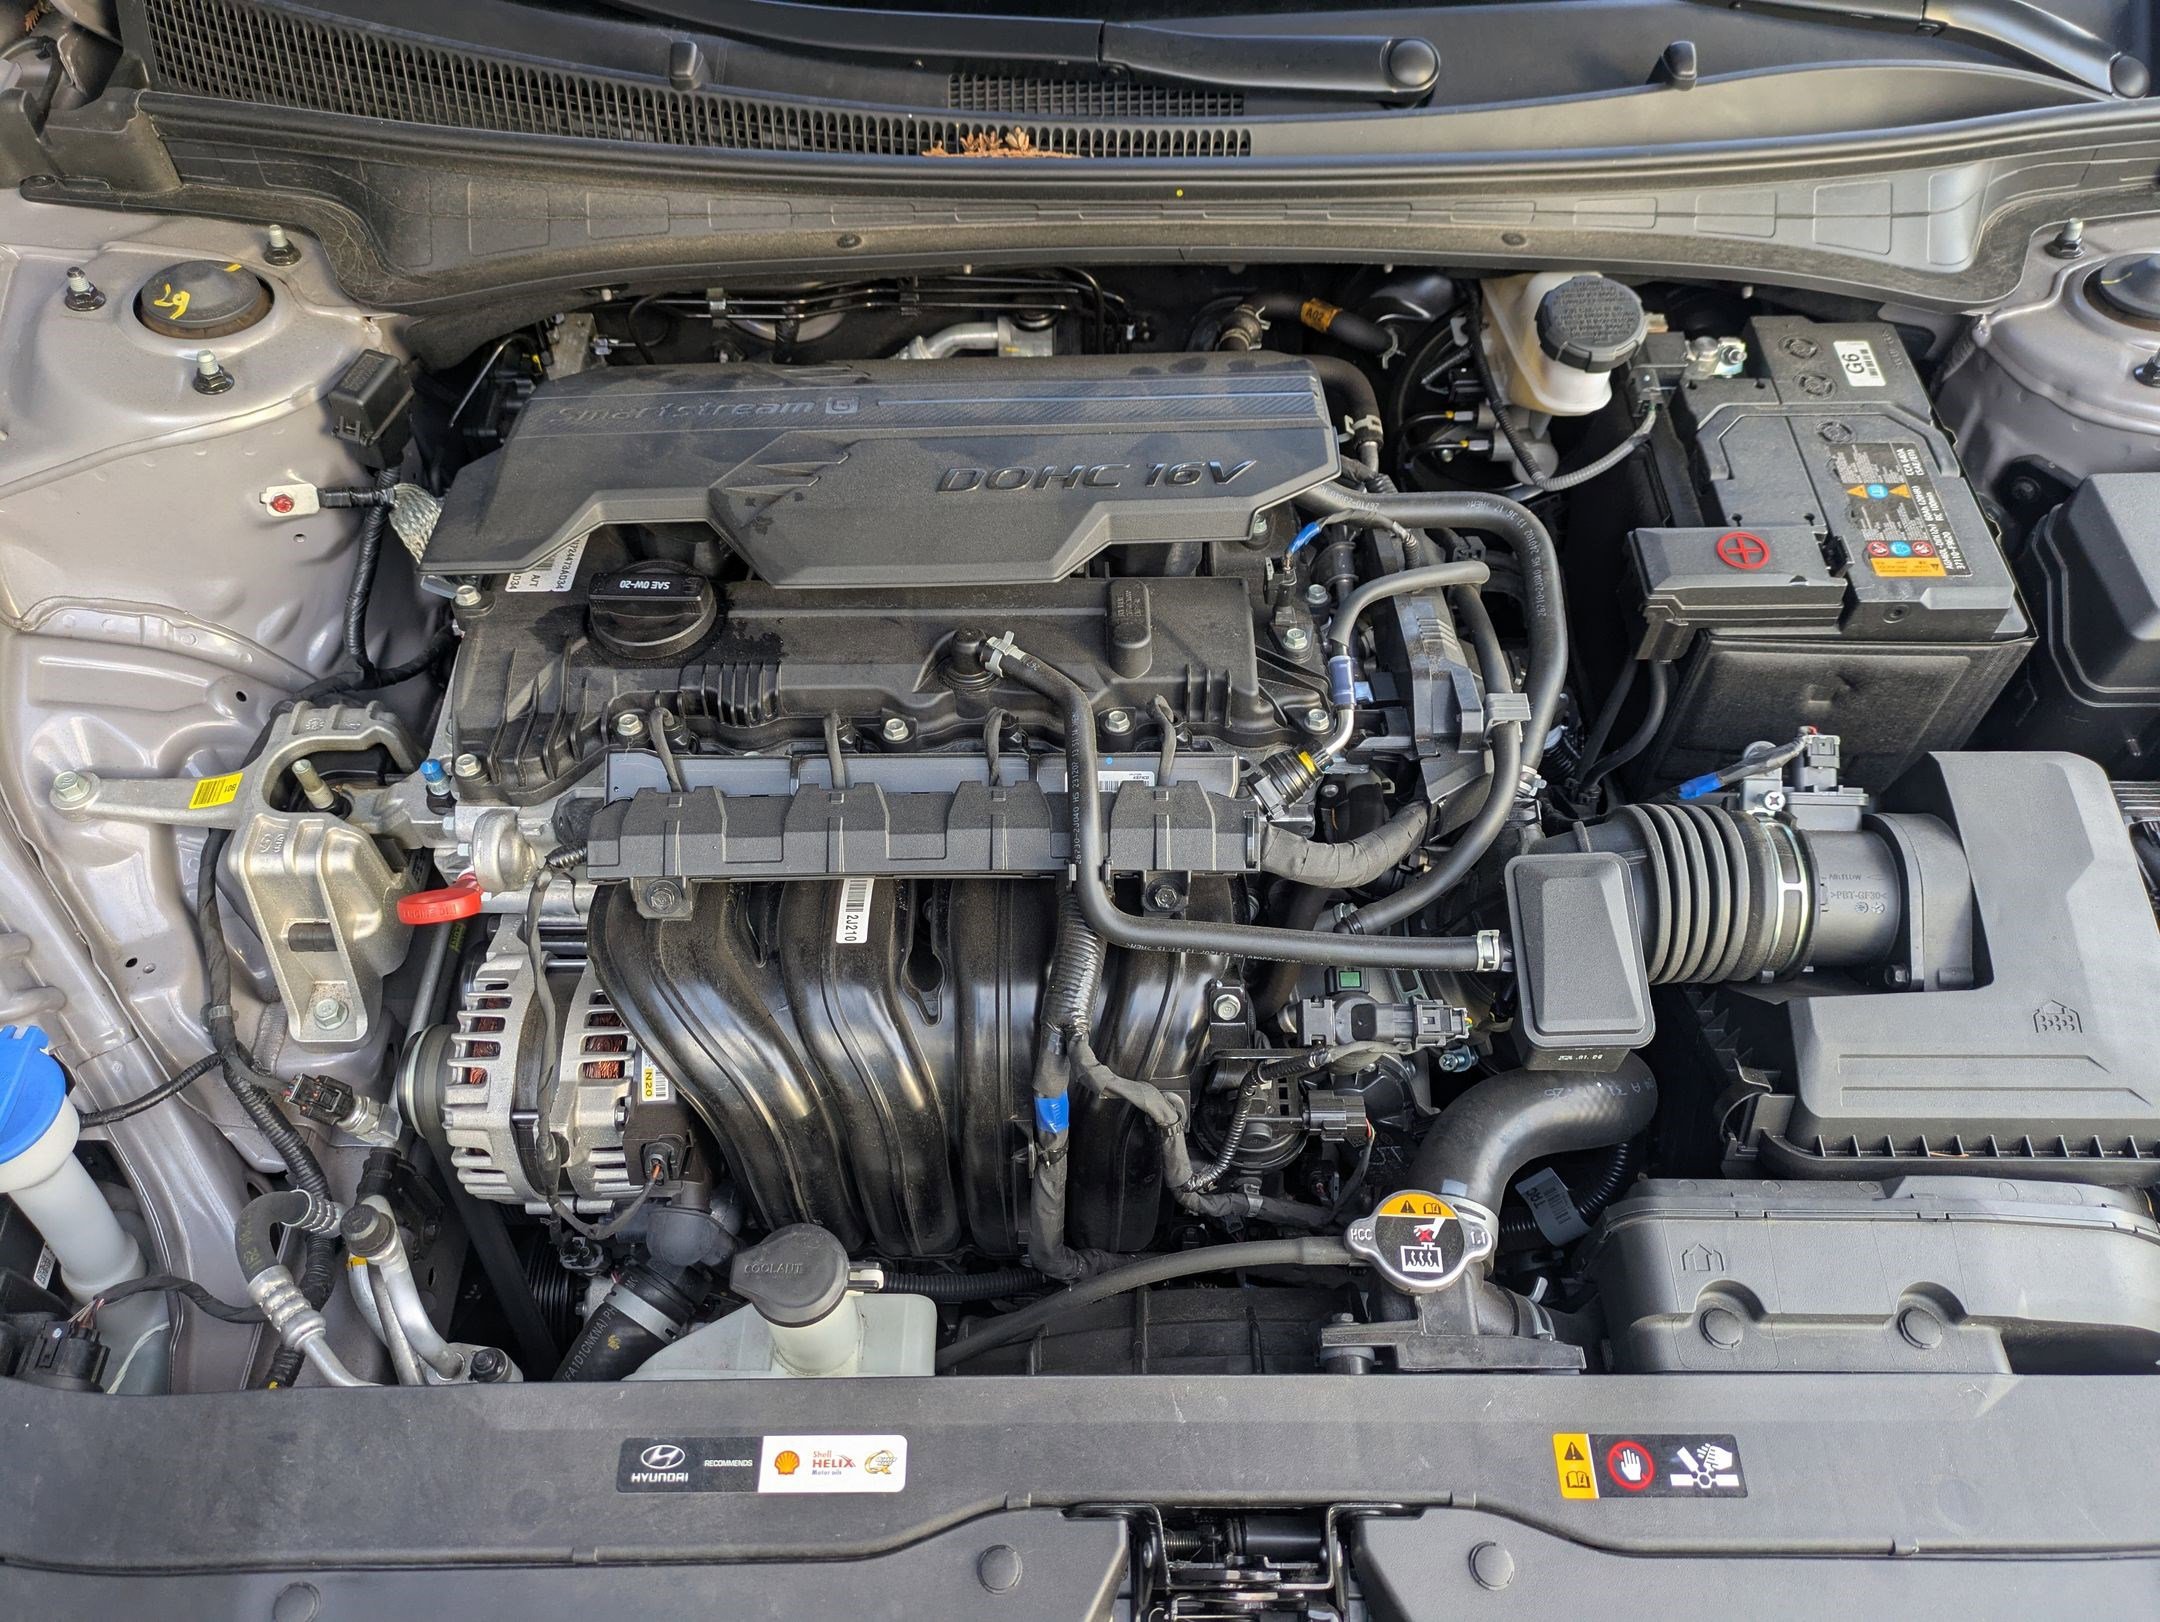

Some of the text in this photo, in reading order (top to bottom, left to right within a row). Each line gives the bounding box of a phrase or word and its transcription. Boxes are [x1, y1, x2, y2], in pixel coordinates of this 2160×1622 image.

[1842, 352, 1865, 374] G6
[937, 459, 1257, 492] DOHC 16V
[508, 575, 522, 589] D34
[619, 580, 671, 590] SAE 0W-20
[844, 914, 859, 941] 2J210
[645, 1071, 653, 1097] N20
[1350, 1228, 1373, 1240] HCC
[744, 1263, 803, 1274] COOLANT
[813, 1449, 832, 1458] Shell
[703, 1459, 753, 1468] RECOMMENDS
[812, 1456, 857, 1469] HELIX
[631, 1472, 689, 1483] HYUNDAI
